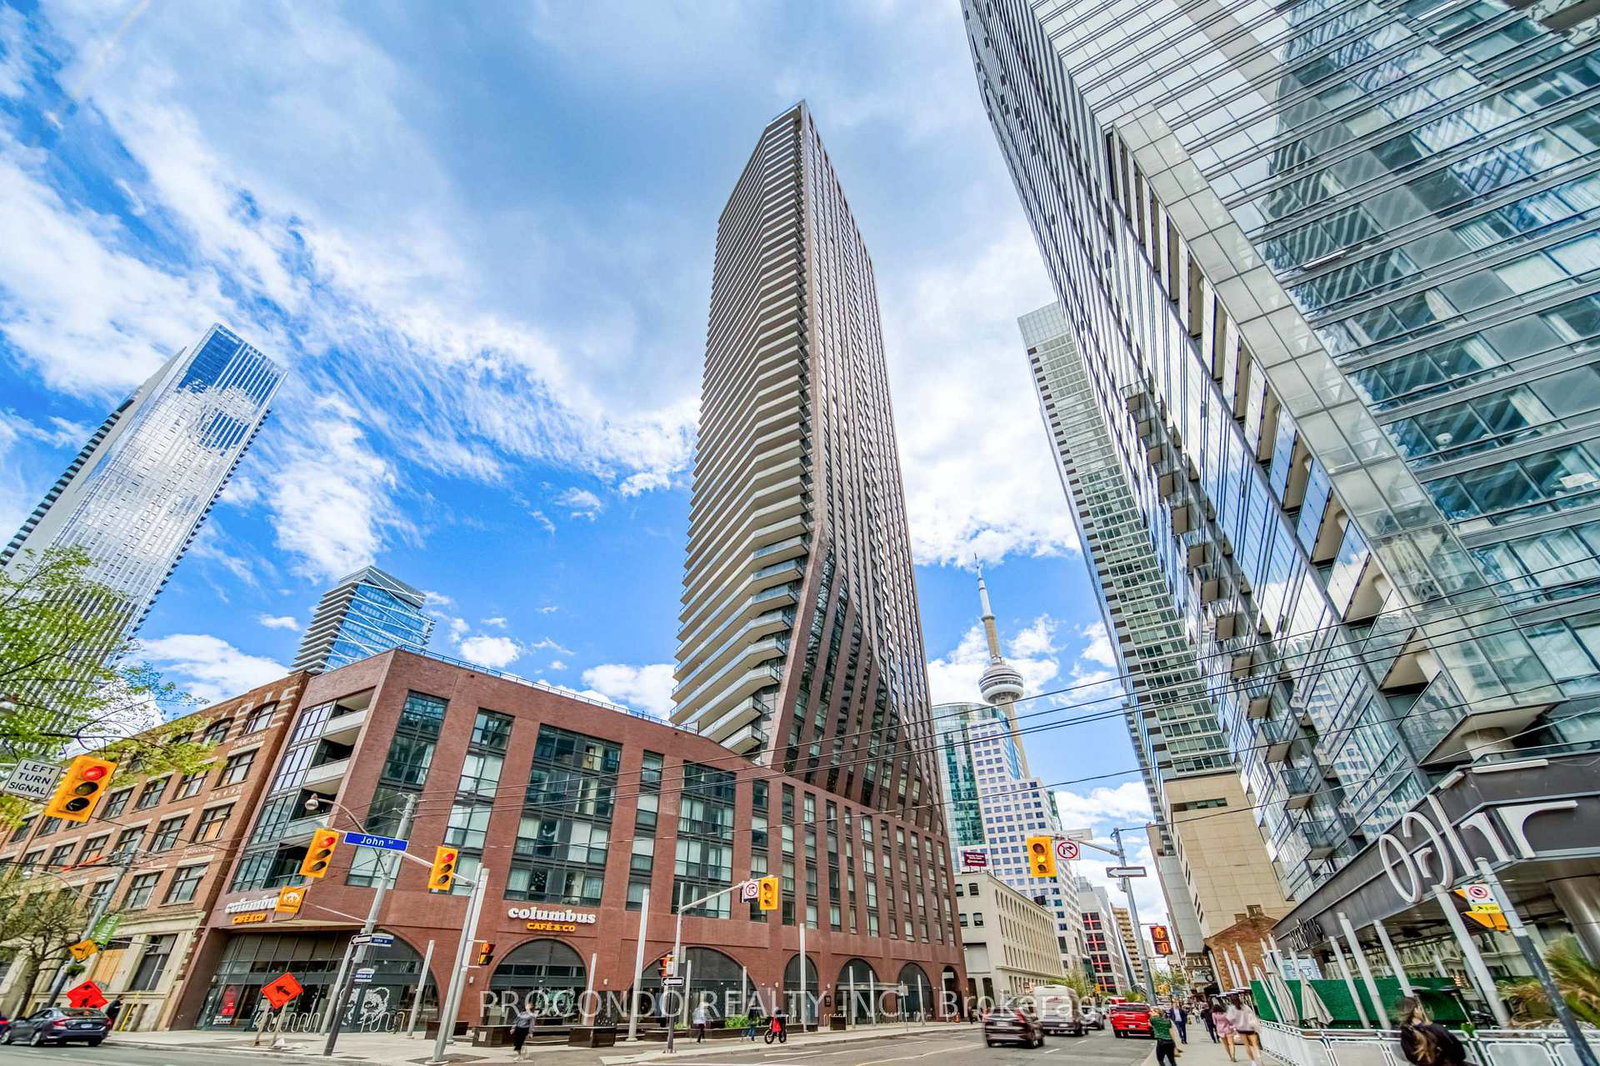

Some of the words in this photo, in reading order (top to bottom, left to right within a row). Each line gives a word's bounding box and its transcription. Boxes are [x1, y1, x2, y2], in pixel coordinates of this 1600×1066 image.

[24, 763, 55, 775] LEFT
[19, 772, 51, 785] TURN
[8, 781, 46, 795] SIGNAL
[361, 836, 385, 847] John
[508, 907, 596, 924] columbus
